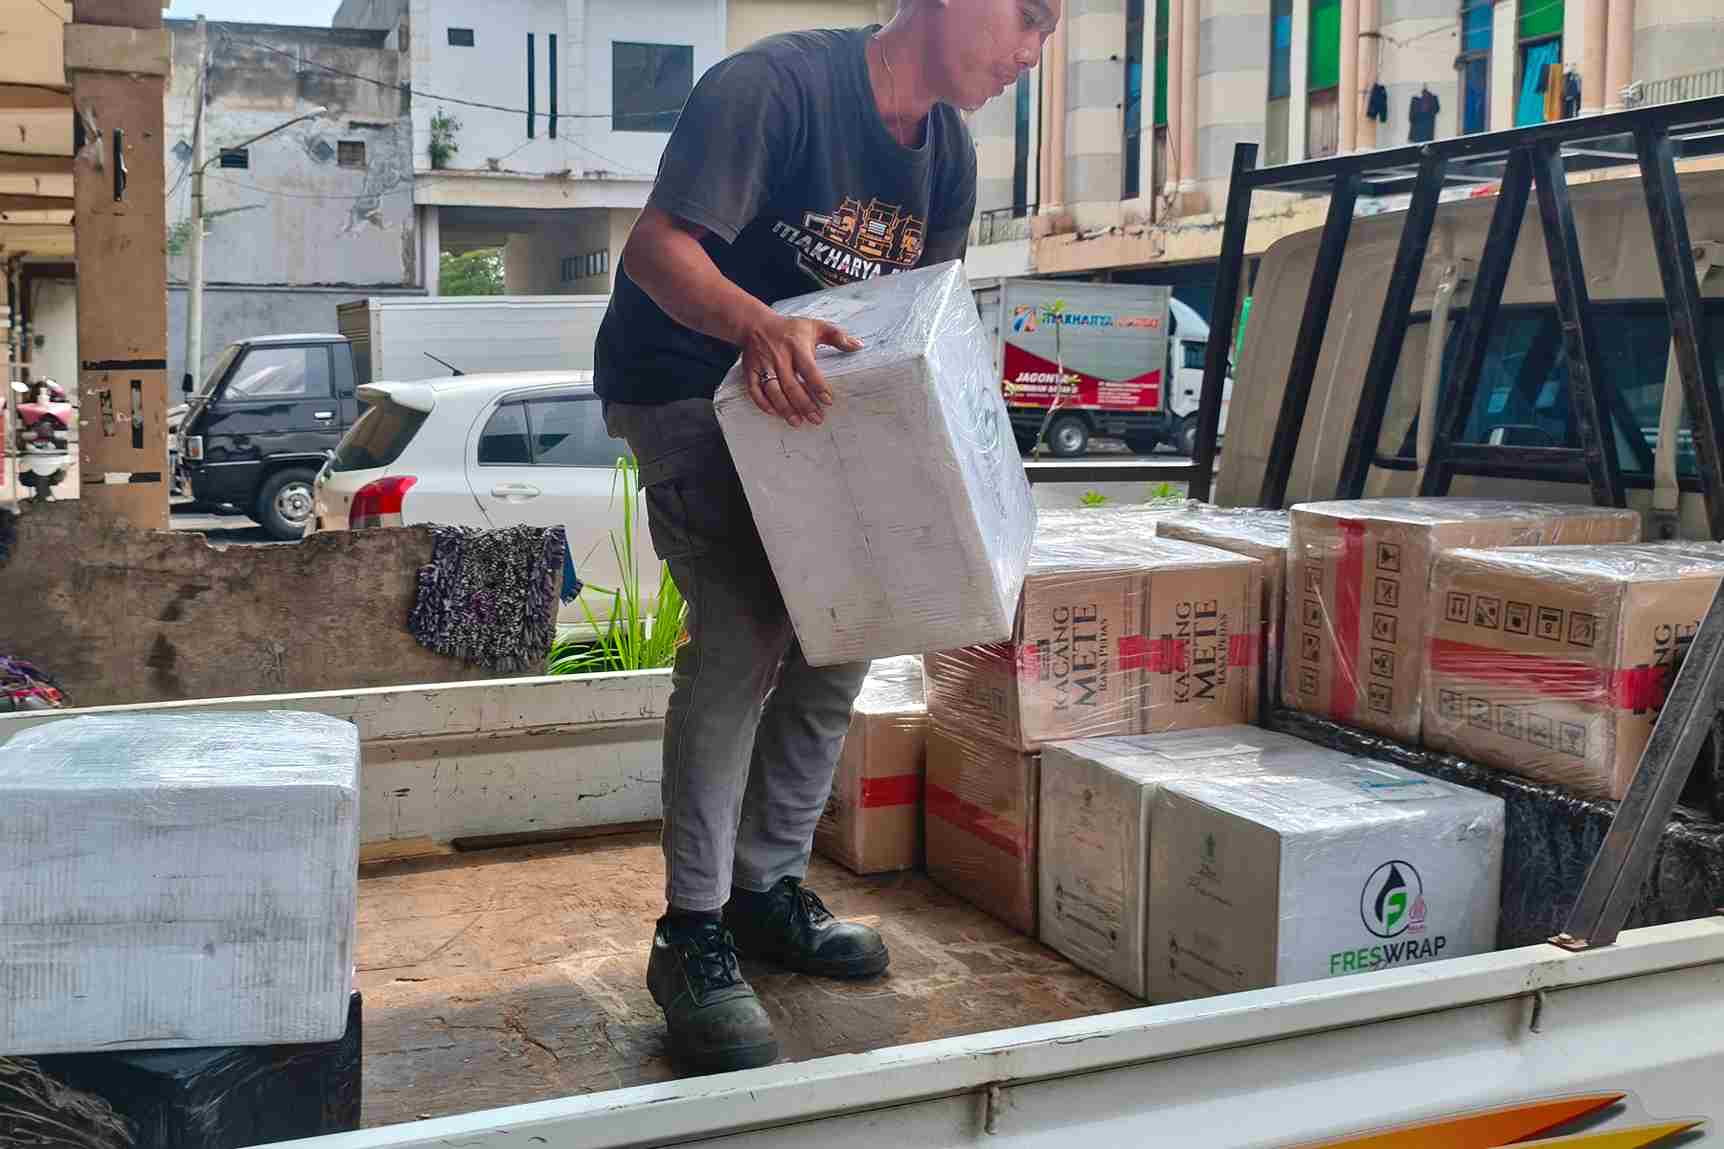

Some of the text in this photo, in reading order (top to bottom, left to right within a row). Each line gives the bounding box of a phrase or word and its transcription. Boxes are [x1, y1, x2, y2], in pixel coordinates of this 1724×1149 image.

[1052, 605, 1070, 711] KACANG
[1072, 603, 1097, 708] METE
[1174, 601, 1192, 704] KACANG
[1192, 599, 1217, 700] METE
[1329, 935, 1447, 975] FRESWRAP
